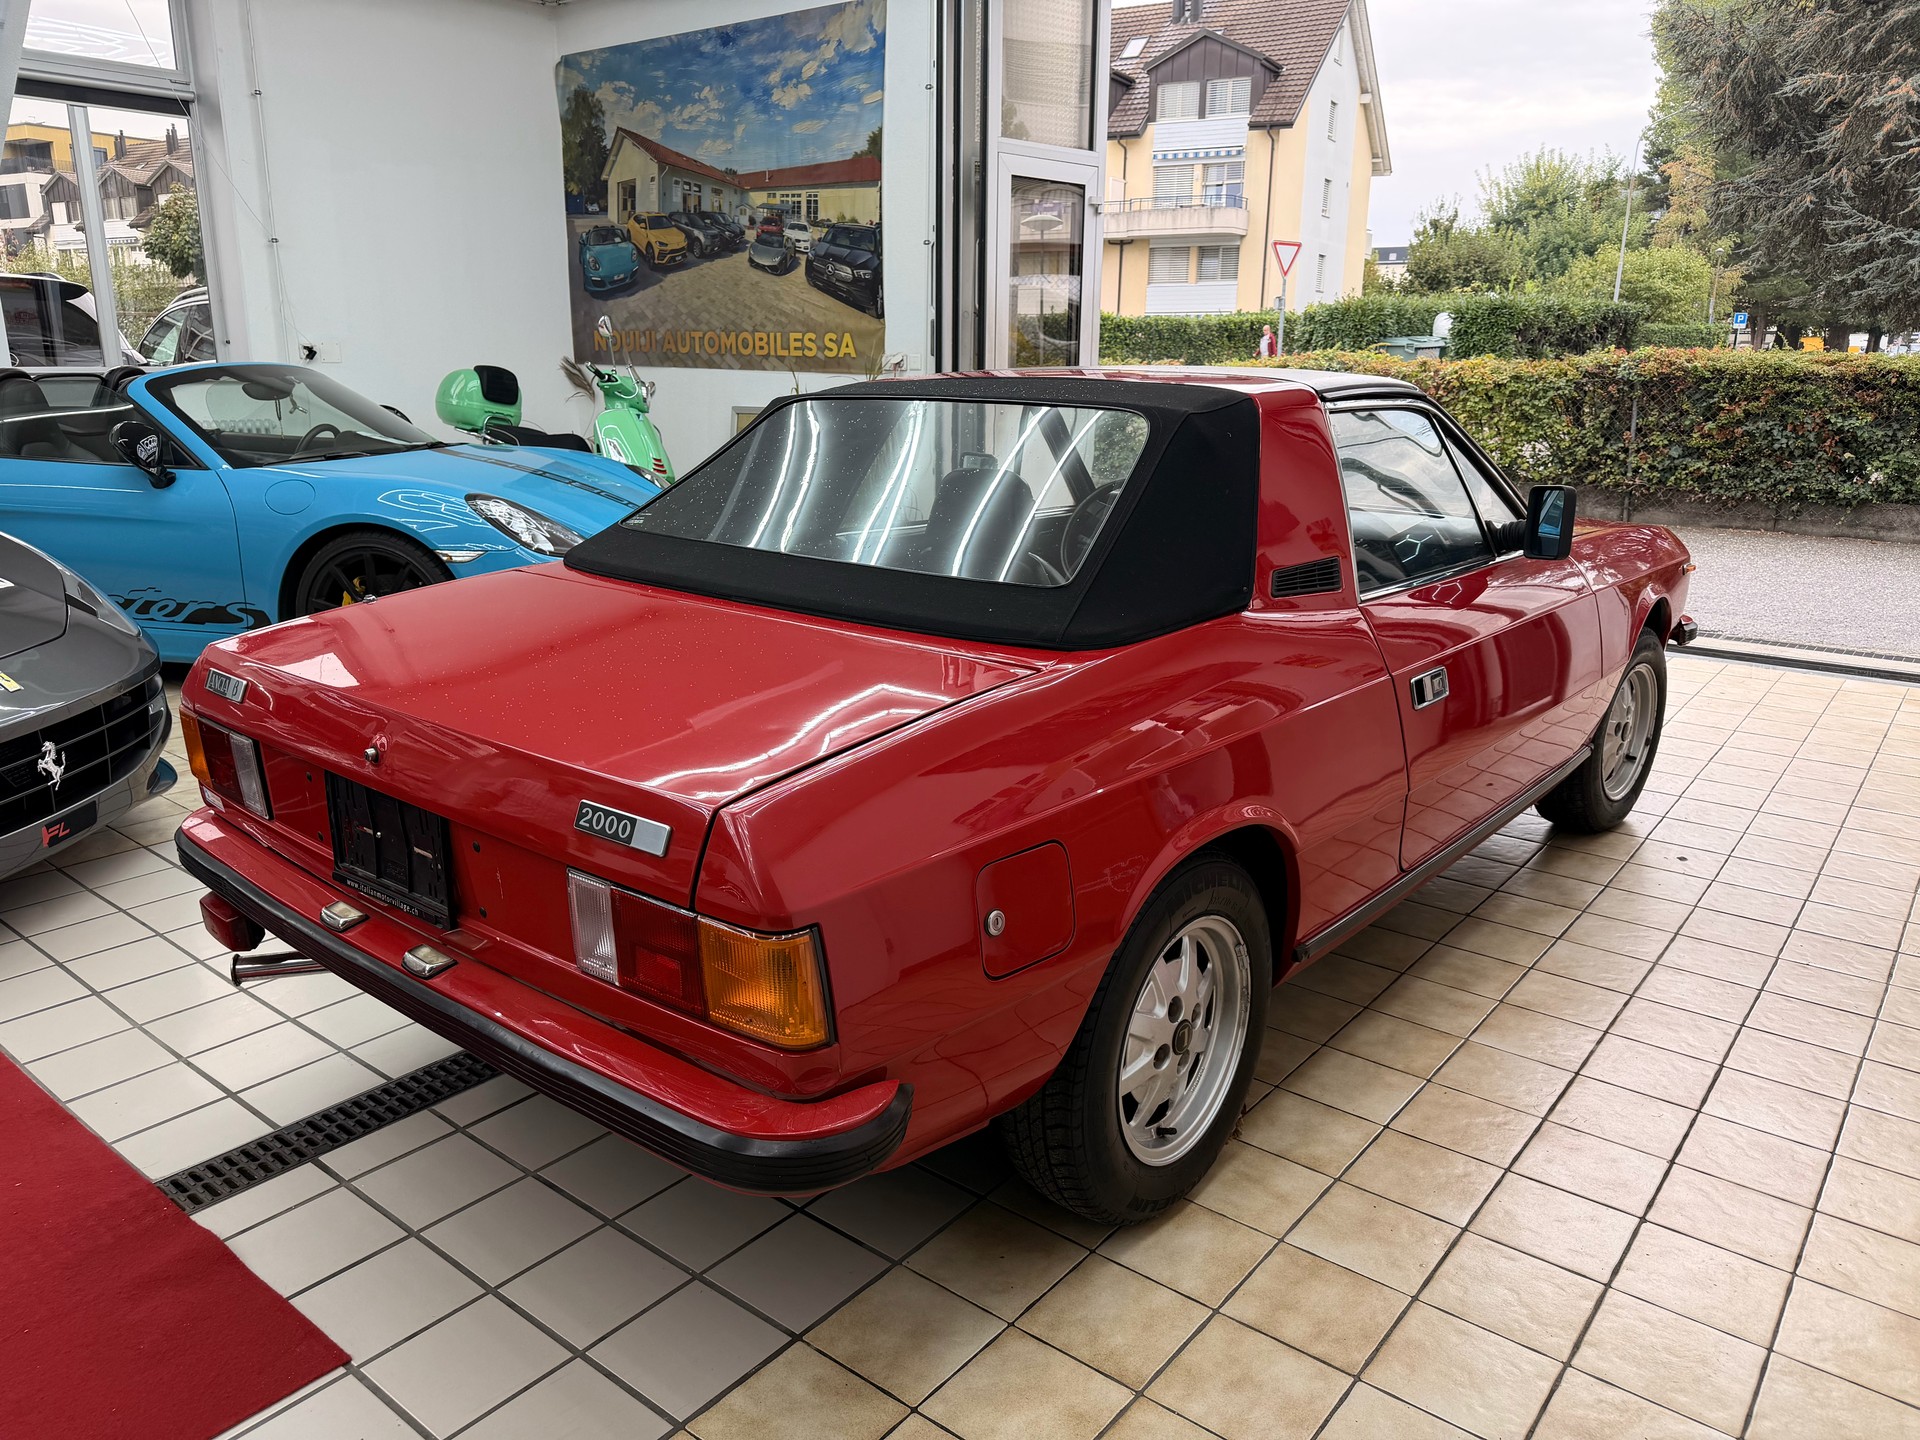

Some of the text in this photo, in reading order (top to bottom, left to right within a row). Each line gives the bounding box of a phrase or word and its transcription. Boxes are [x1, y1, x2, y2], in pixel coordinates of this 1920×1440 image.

[594, 330, 857, 358] NOUIJI AUTOMOBILES SA
[579, 807, 631, 838] 2000
[346, 879, 419, 916] www.italianmotorvillage.ch
